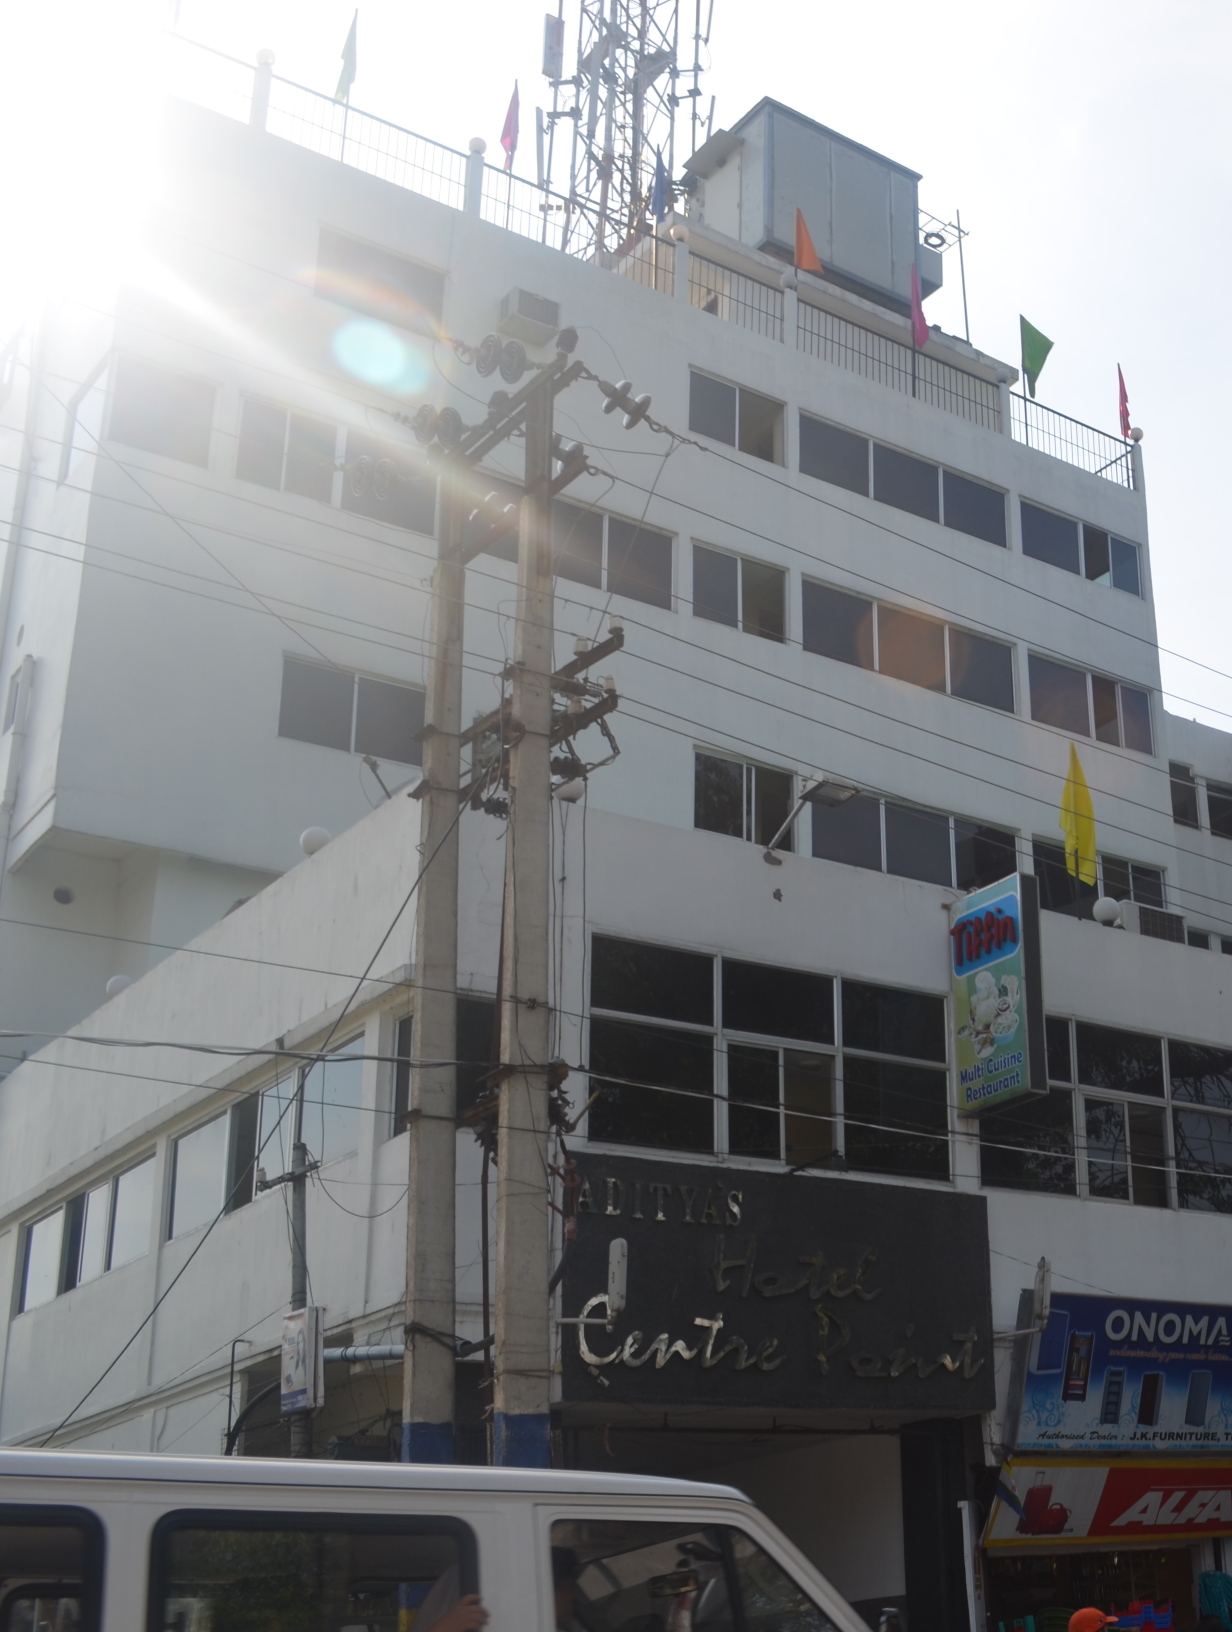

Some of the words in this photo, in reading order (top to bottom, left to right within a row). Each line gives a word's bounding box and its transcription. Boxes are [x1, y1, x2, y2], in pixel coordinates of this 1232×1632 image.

[950, 908, 1016, 966] Tiffin
[960, 1064, 984, 1085] Multi
[987, 1052, 1023, 1074] Cuisine
[966, 1072, 1020, 1103] Restaurant
[578, 1176, 742, 1226] ADITYA'S
[710, 1233, 884, 1301] Hotel
[578, 1294, 786, 1372] Centre
[814, 1304, 985, 1380] Point
[1105, 1309, 1231, 1346] ONOMA
[1036, 1431, 1086, 1441] Authorised
[1090, 1431, 1117, 1441] Dealer
[1110, 1490, 1232, 1526] ALFA
